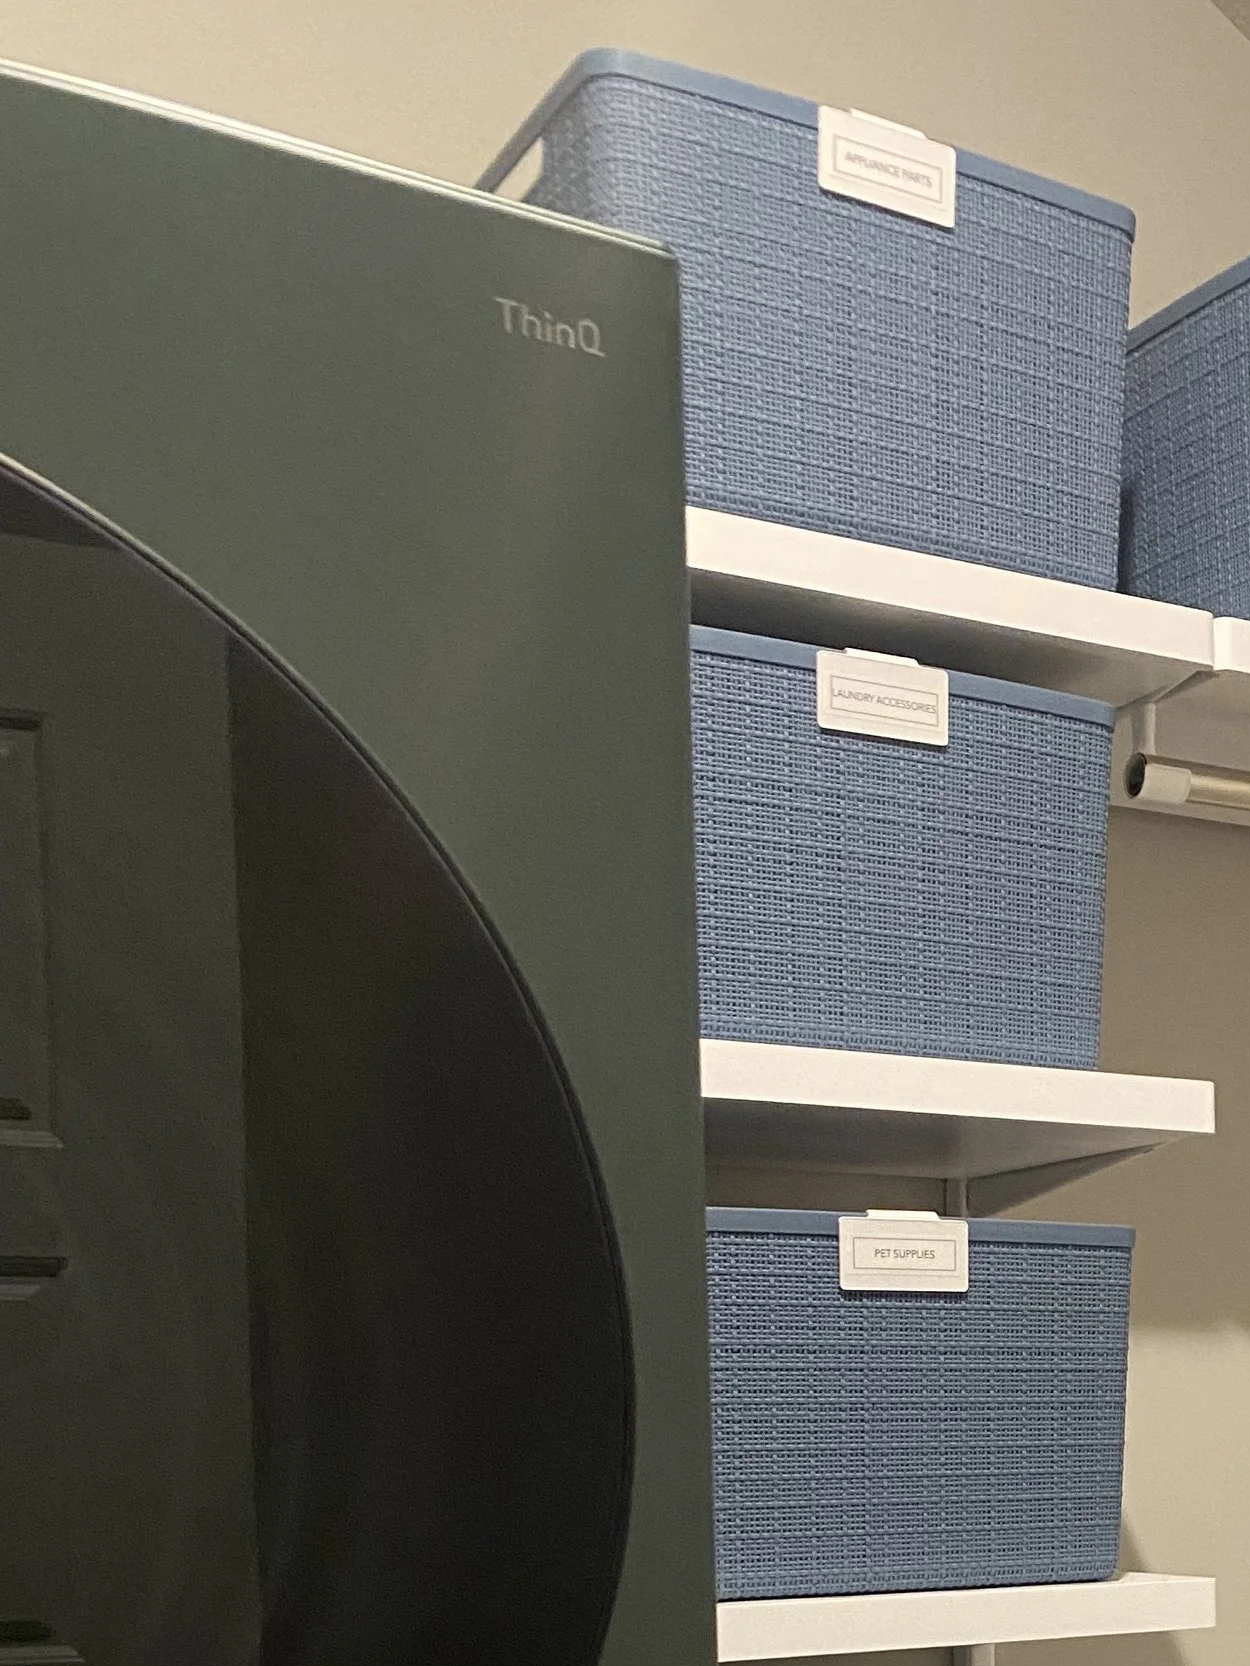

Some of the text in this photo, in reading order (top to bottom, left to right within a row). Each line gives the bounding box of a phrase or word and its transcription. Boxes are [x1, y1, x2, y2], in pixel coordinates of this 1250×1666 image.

[495, 297, 607, 357] ThinQ
[832, 687, 937, 714] LAUNDRY ACCESSORIES
[874, 1248, 936, 1259] PET SUPPLIES
